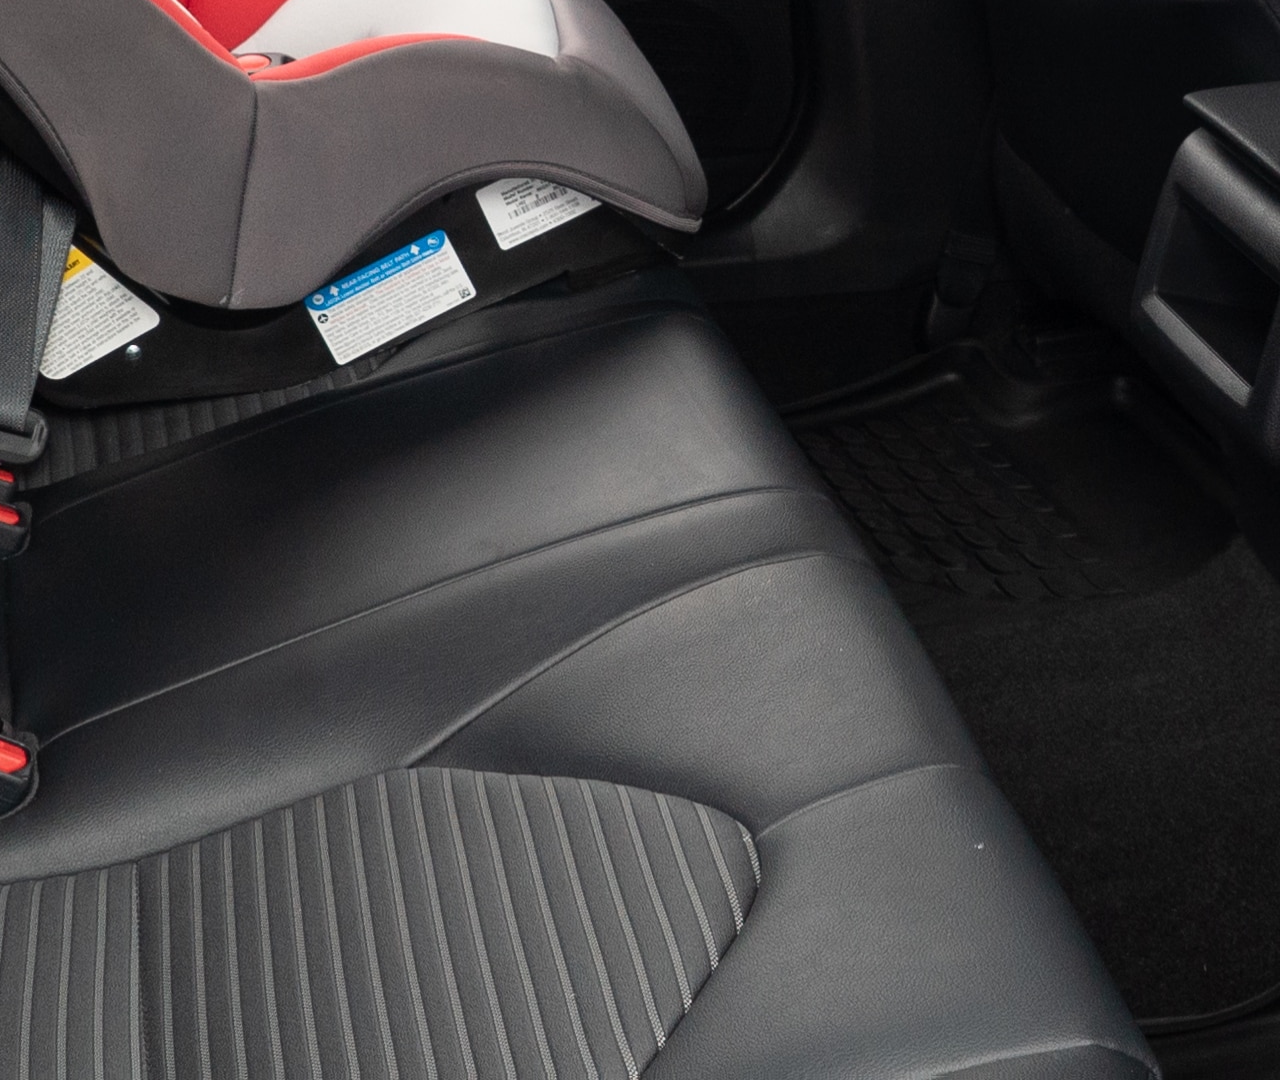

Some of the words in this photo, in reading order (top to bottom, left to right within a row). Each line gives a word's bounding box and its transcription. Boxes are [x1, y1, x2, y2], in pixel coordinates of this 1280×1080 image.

[340, 265, 380, 290] REAR-FACING
[379, 259, 394, 270] BELT
[393, 250, 410, 263] PATH
